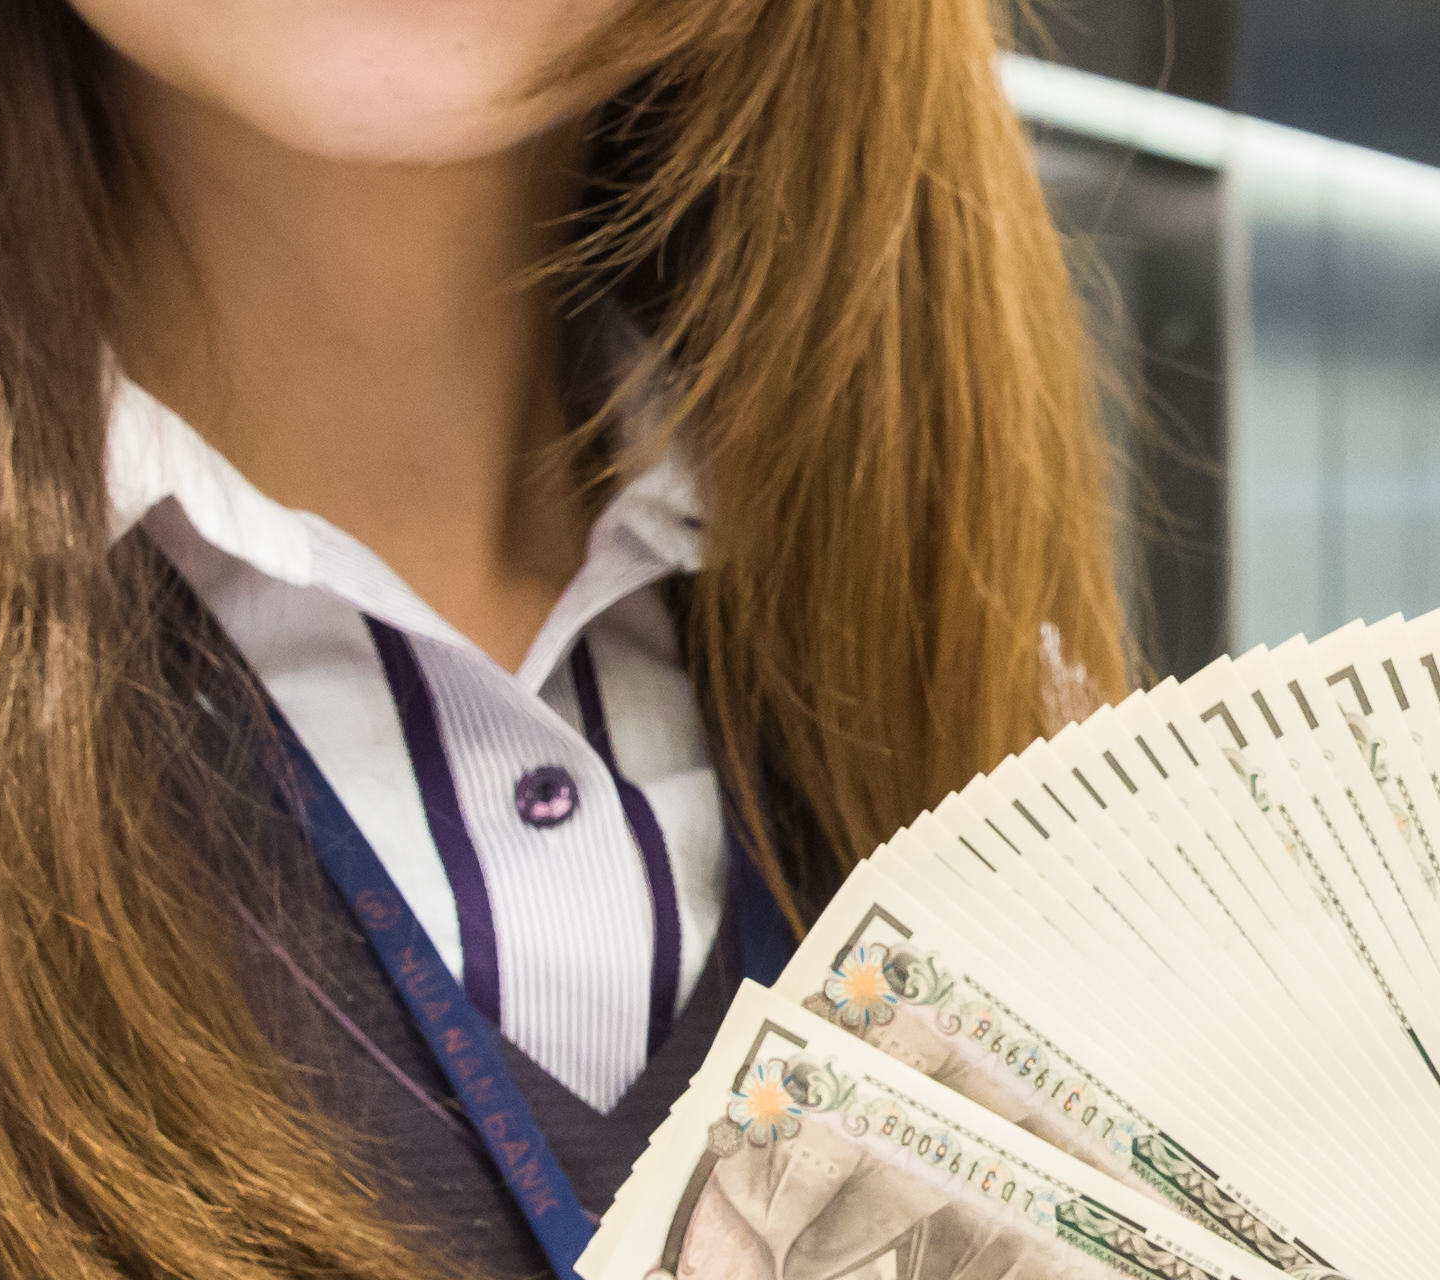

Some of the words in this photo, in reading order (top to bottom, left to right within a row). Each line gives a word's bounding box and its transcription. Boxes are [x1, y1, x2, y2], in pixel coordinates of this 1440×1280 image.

[435, 1027, 503, 1104] NAN
[483, 1112, 559, 1217] BANK
[973, 1020, 1114, 1140] LD319599B
[882, 1114, 1035, 1213] LD319600B
